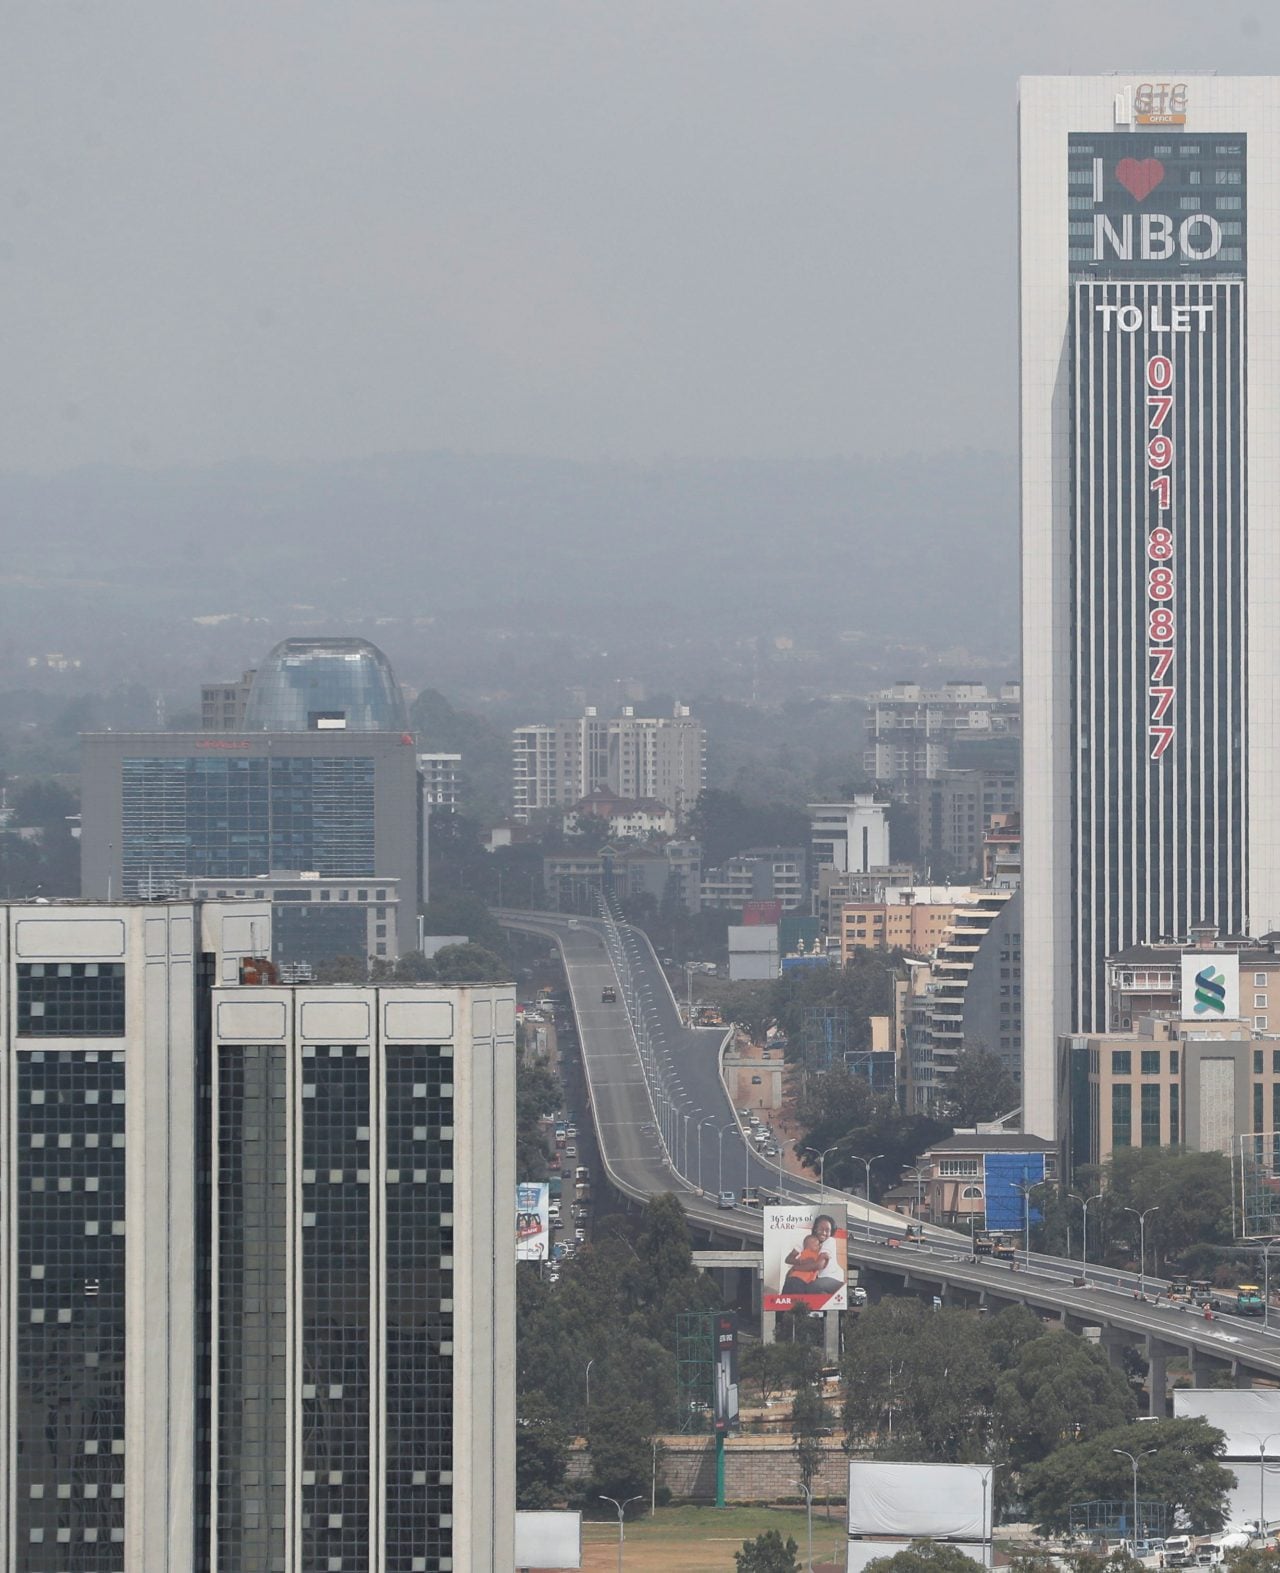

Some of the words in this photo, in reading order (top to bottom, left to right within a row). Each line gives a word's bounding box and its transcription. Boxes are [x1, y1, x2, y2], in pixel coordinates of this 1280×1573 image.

[1093, 158, 1103, 202] I
[1093, 214, 1222, 260] NBO
[1096, 305, 1143, 332] TO
[1151, 305, 1214, 332] LET
[786, 1214, 802, 1223] days
[804, 1214, 813, 1222] of
